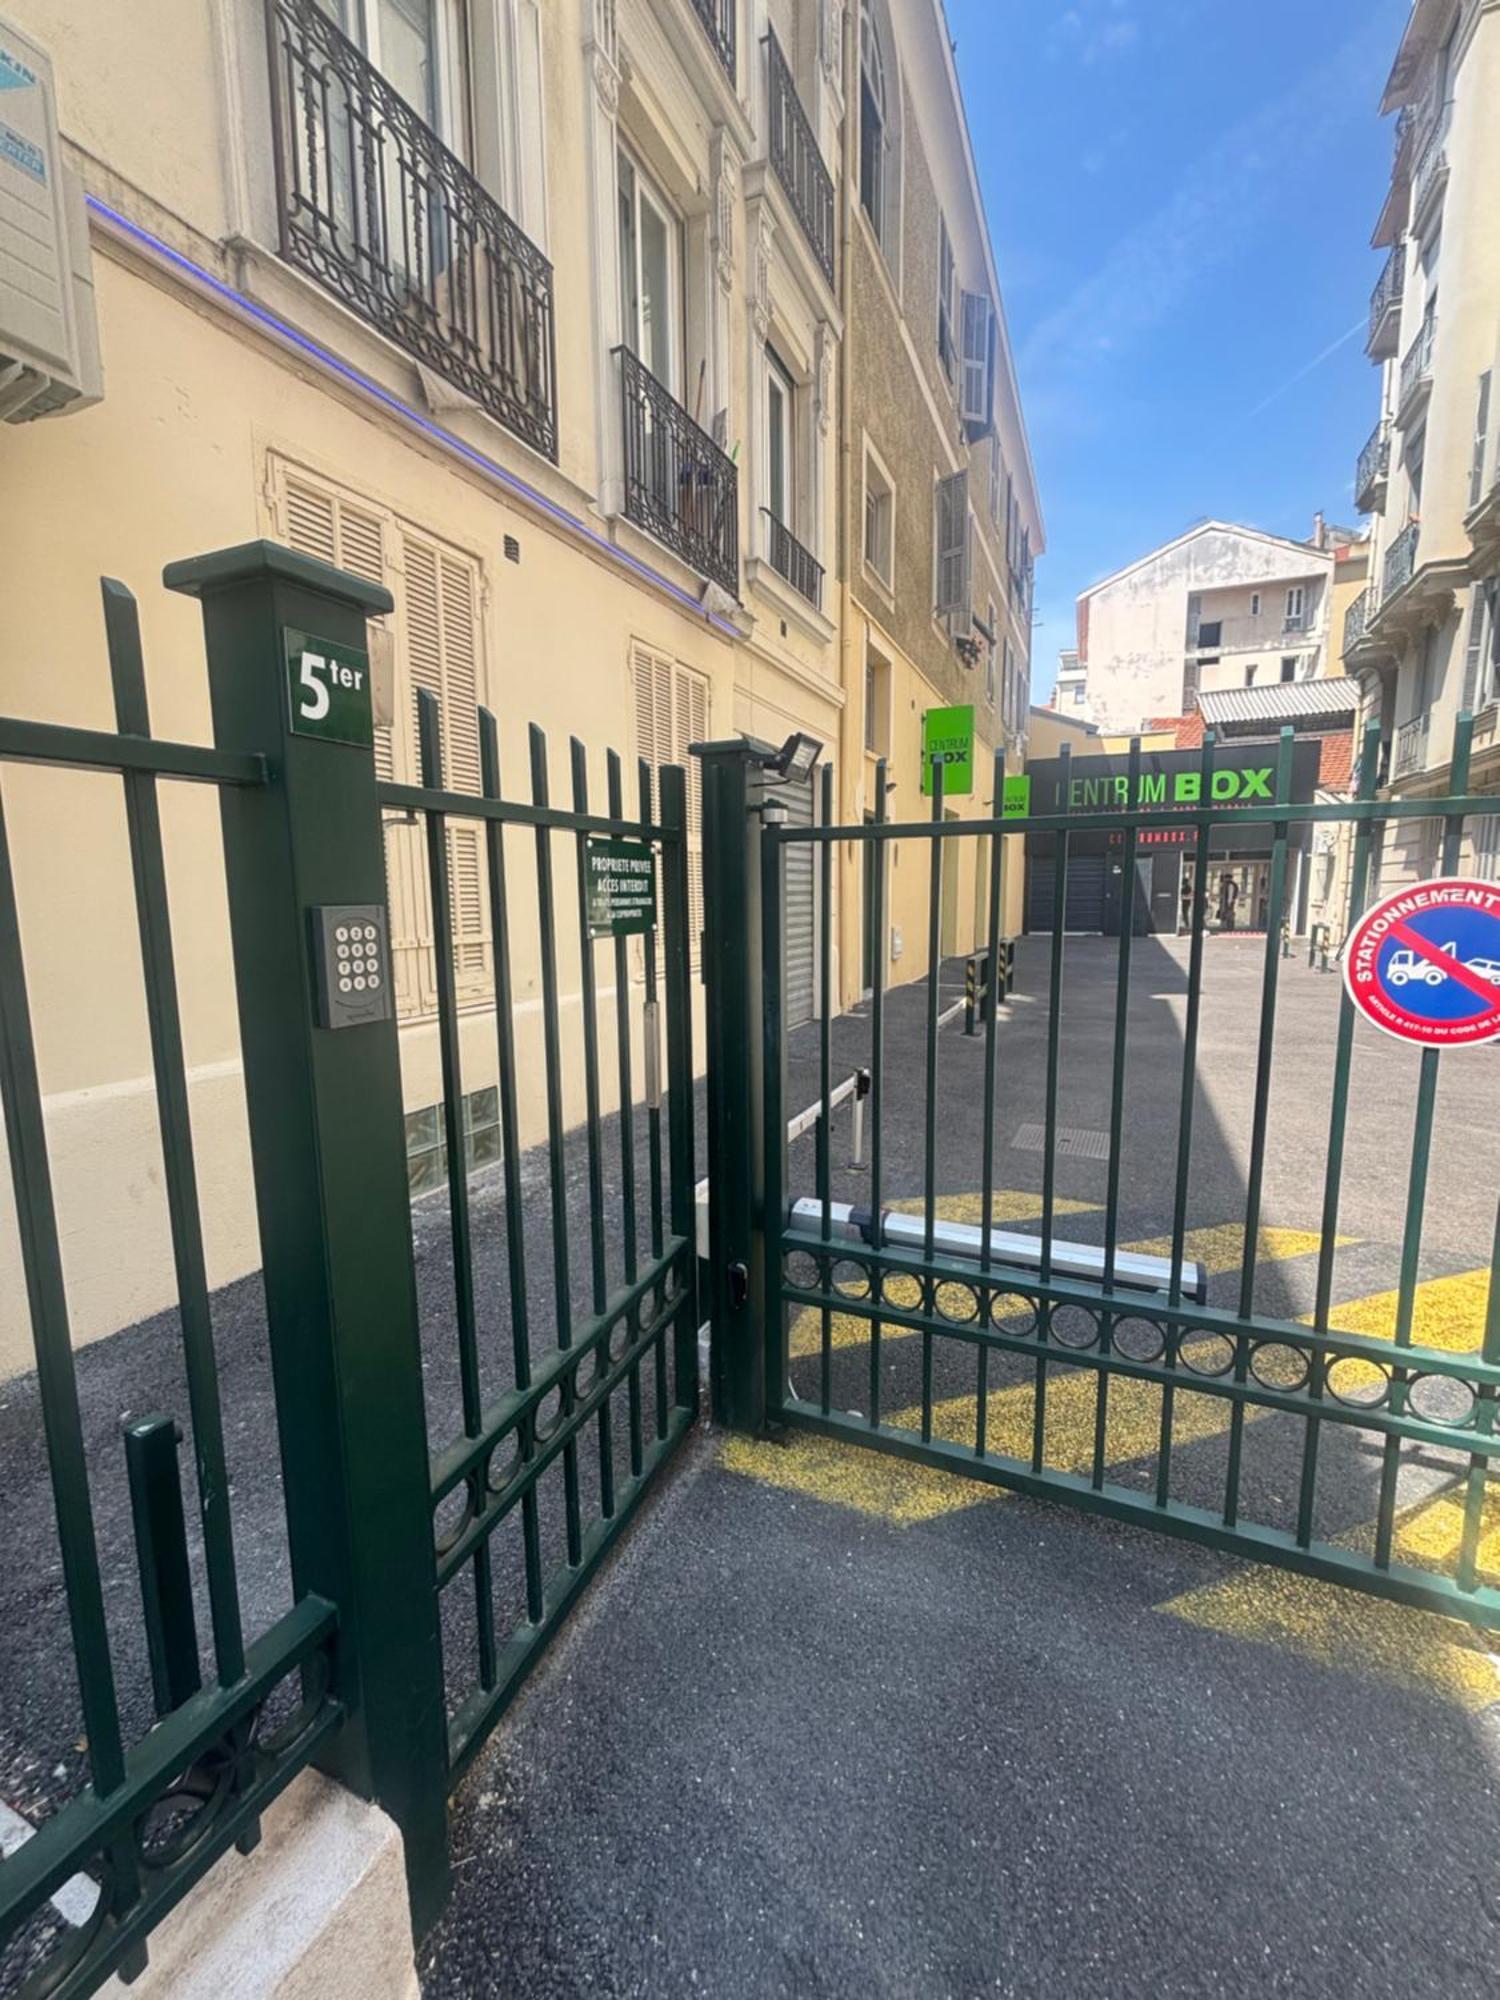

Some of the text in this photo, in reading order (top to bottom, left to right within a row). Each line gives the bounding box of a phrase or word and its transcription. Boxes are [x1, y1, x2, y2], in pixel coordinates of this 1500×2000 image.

[1056, 767, 1274, 806] ENTRUM BOX
[1356, 888, 1500, 982] STATIONNEMENT
[1368, 994, 1397, 1021] ARTICLE
[1433, 1027, 1448, 1035] DU
[1449, 1024, 1477, 1035] CODE
[1477, 1019, 1492, 1030] DE
